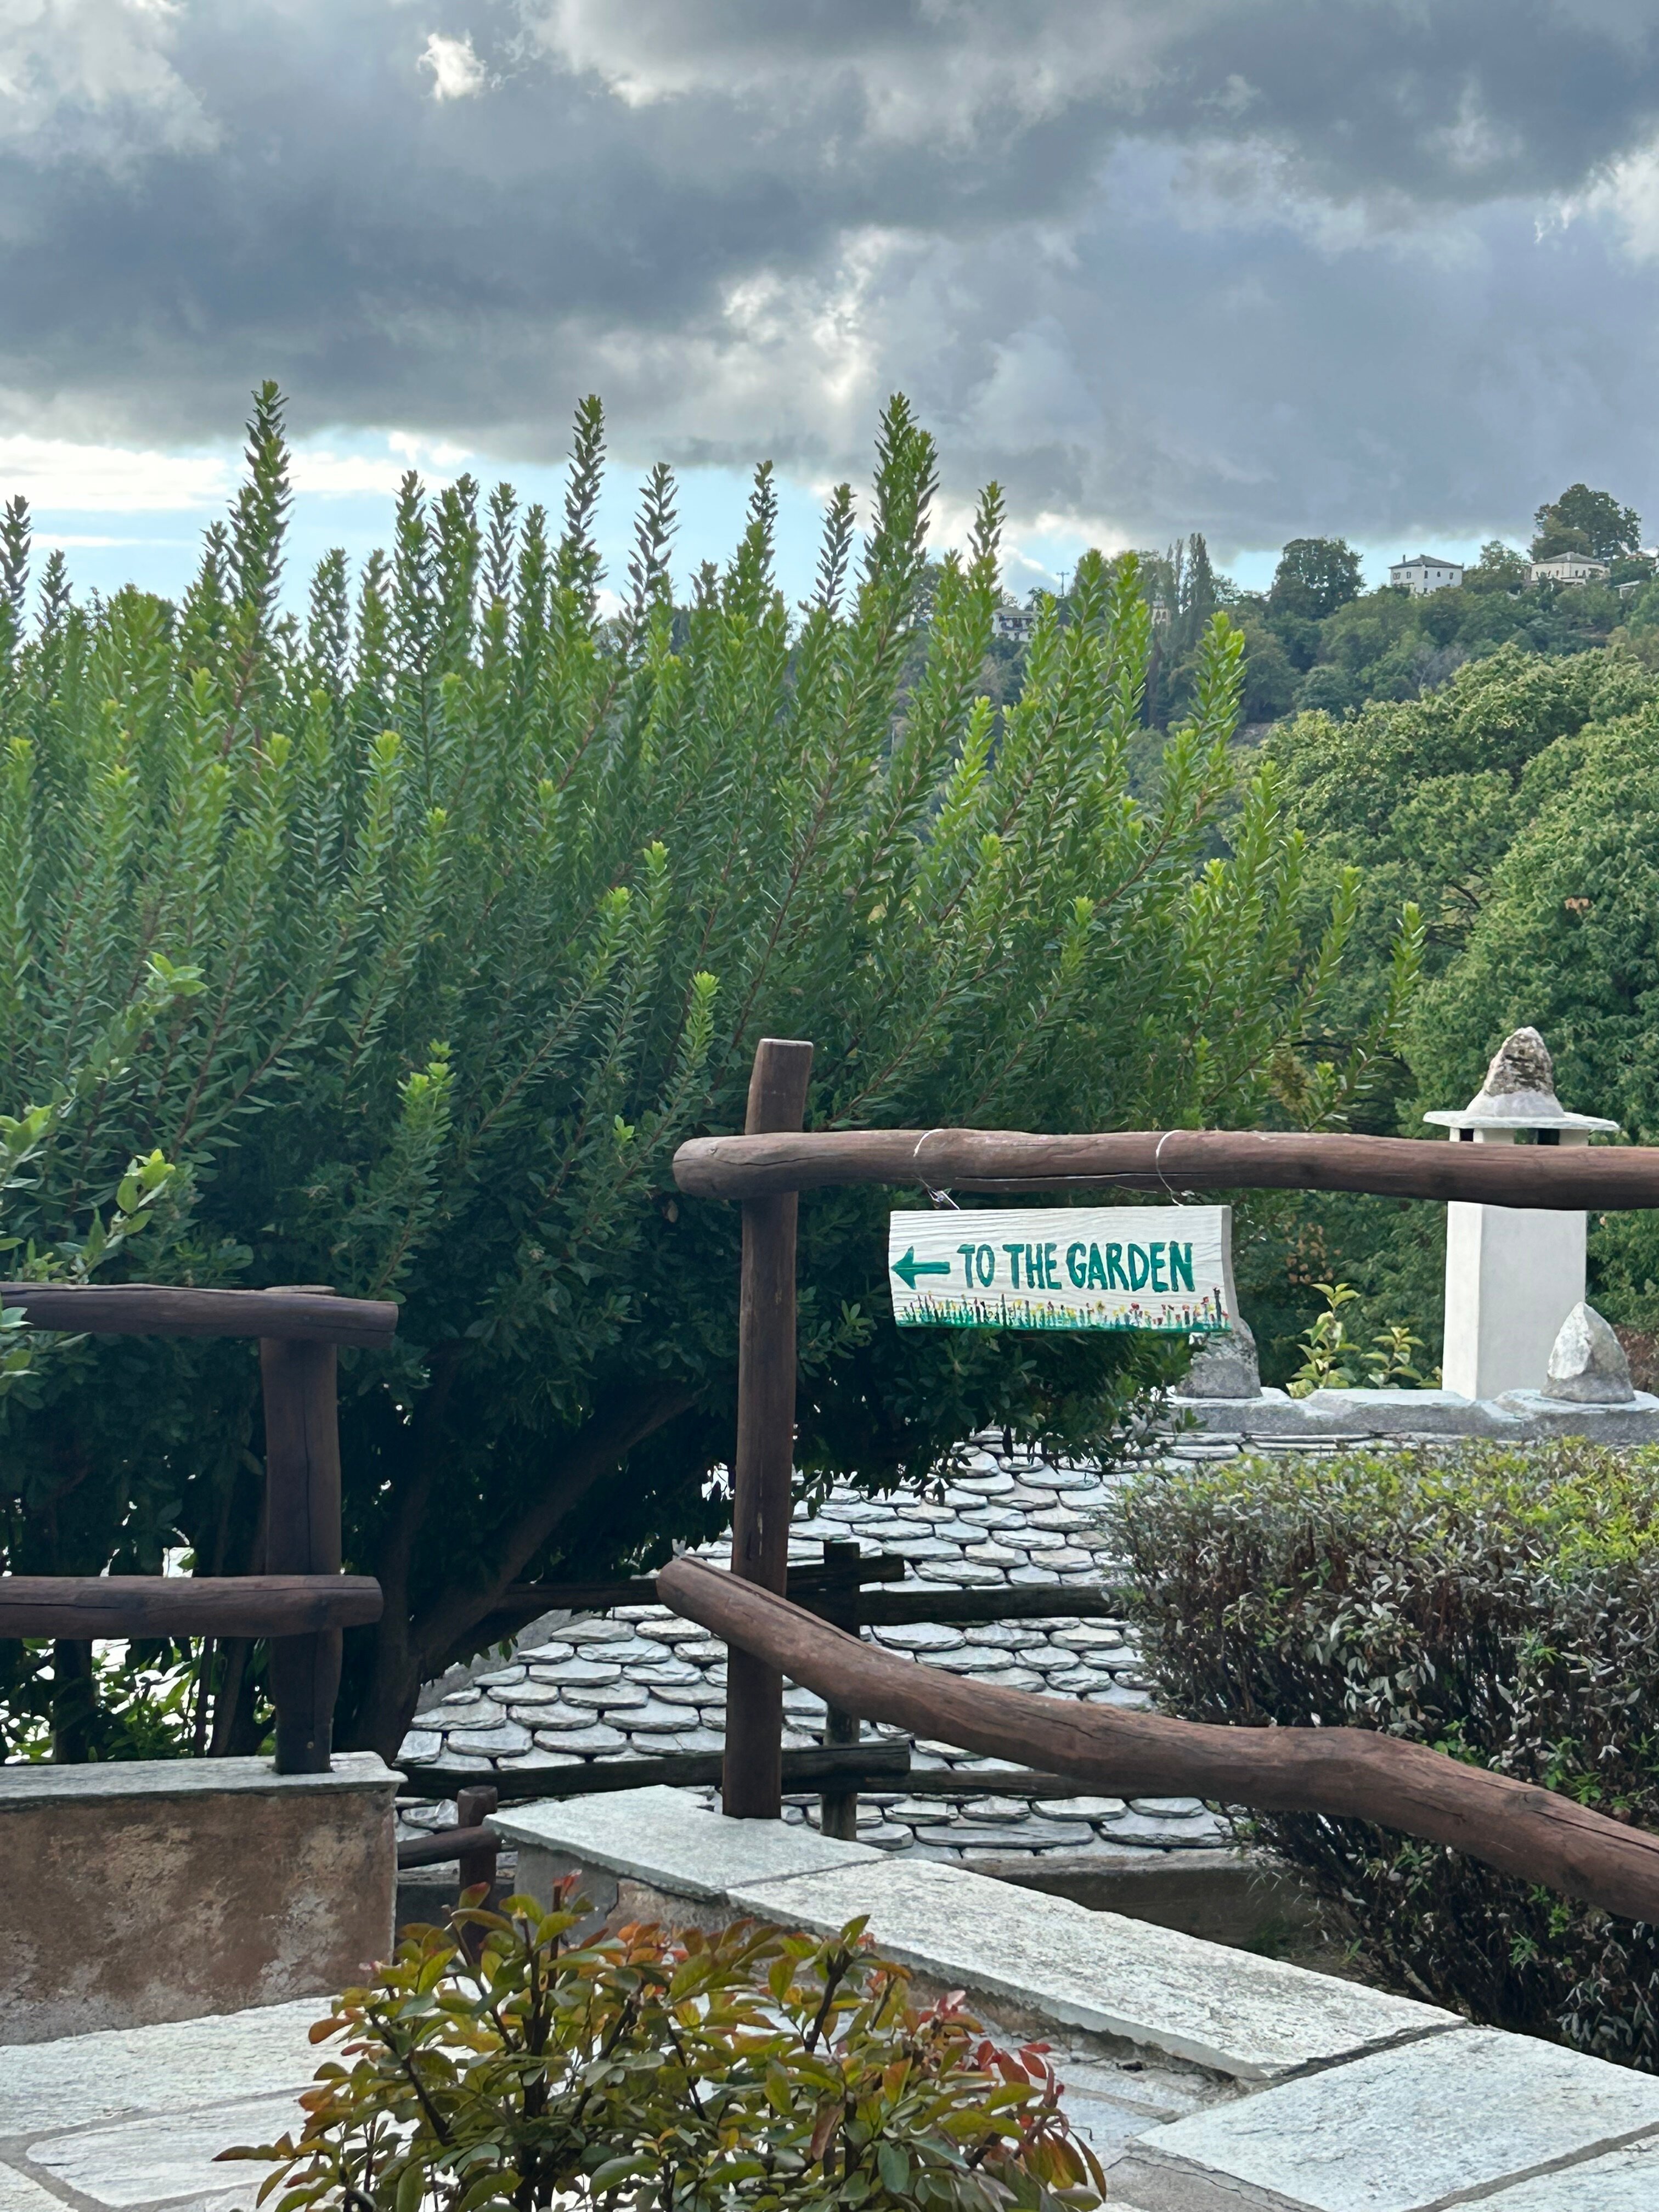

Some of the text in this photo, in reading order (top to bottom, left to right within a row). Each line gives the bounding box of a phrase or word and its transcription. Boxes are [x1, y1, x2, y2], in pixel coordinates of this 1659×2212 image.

[956, 1241, 1195, 1292] TO THE GARDEN
